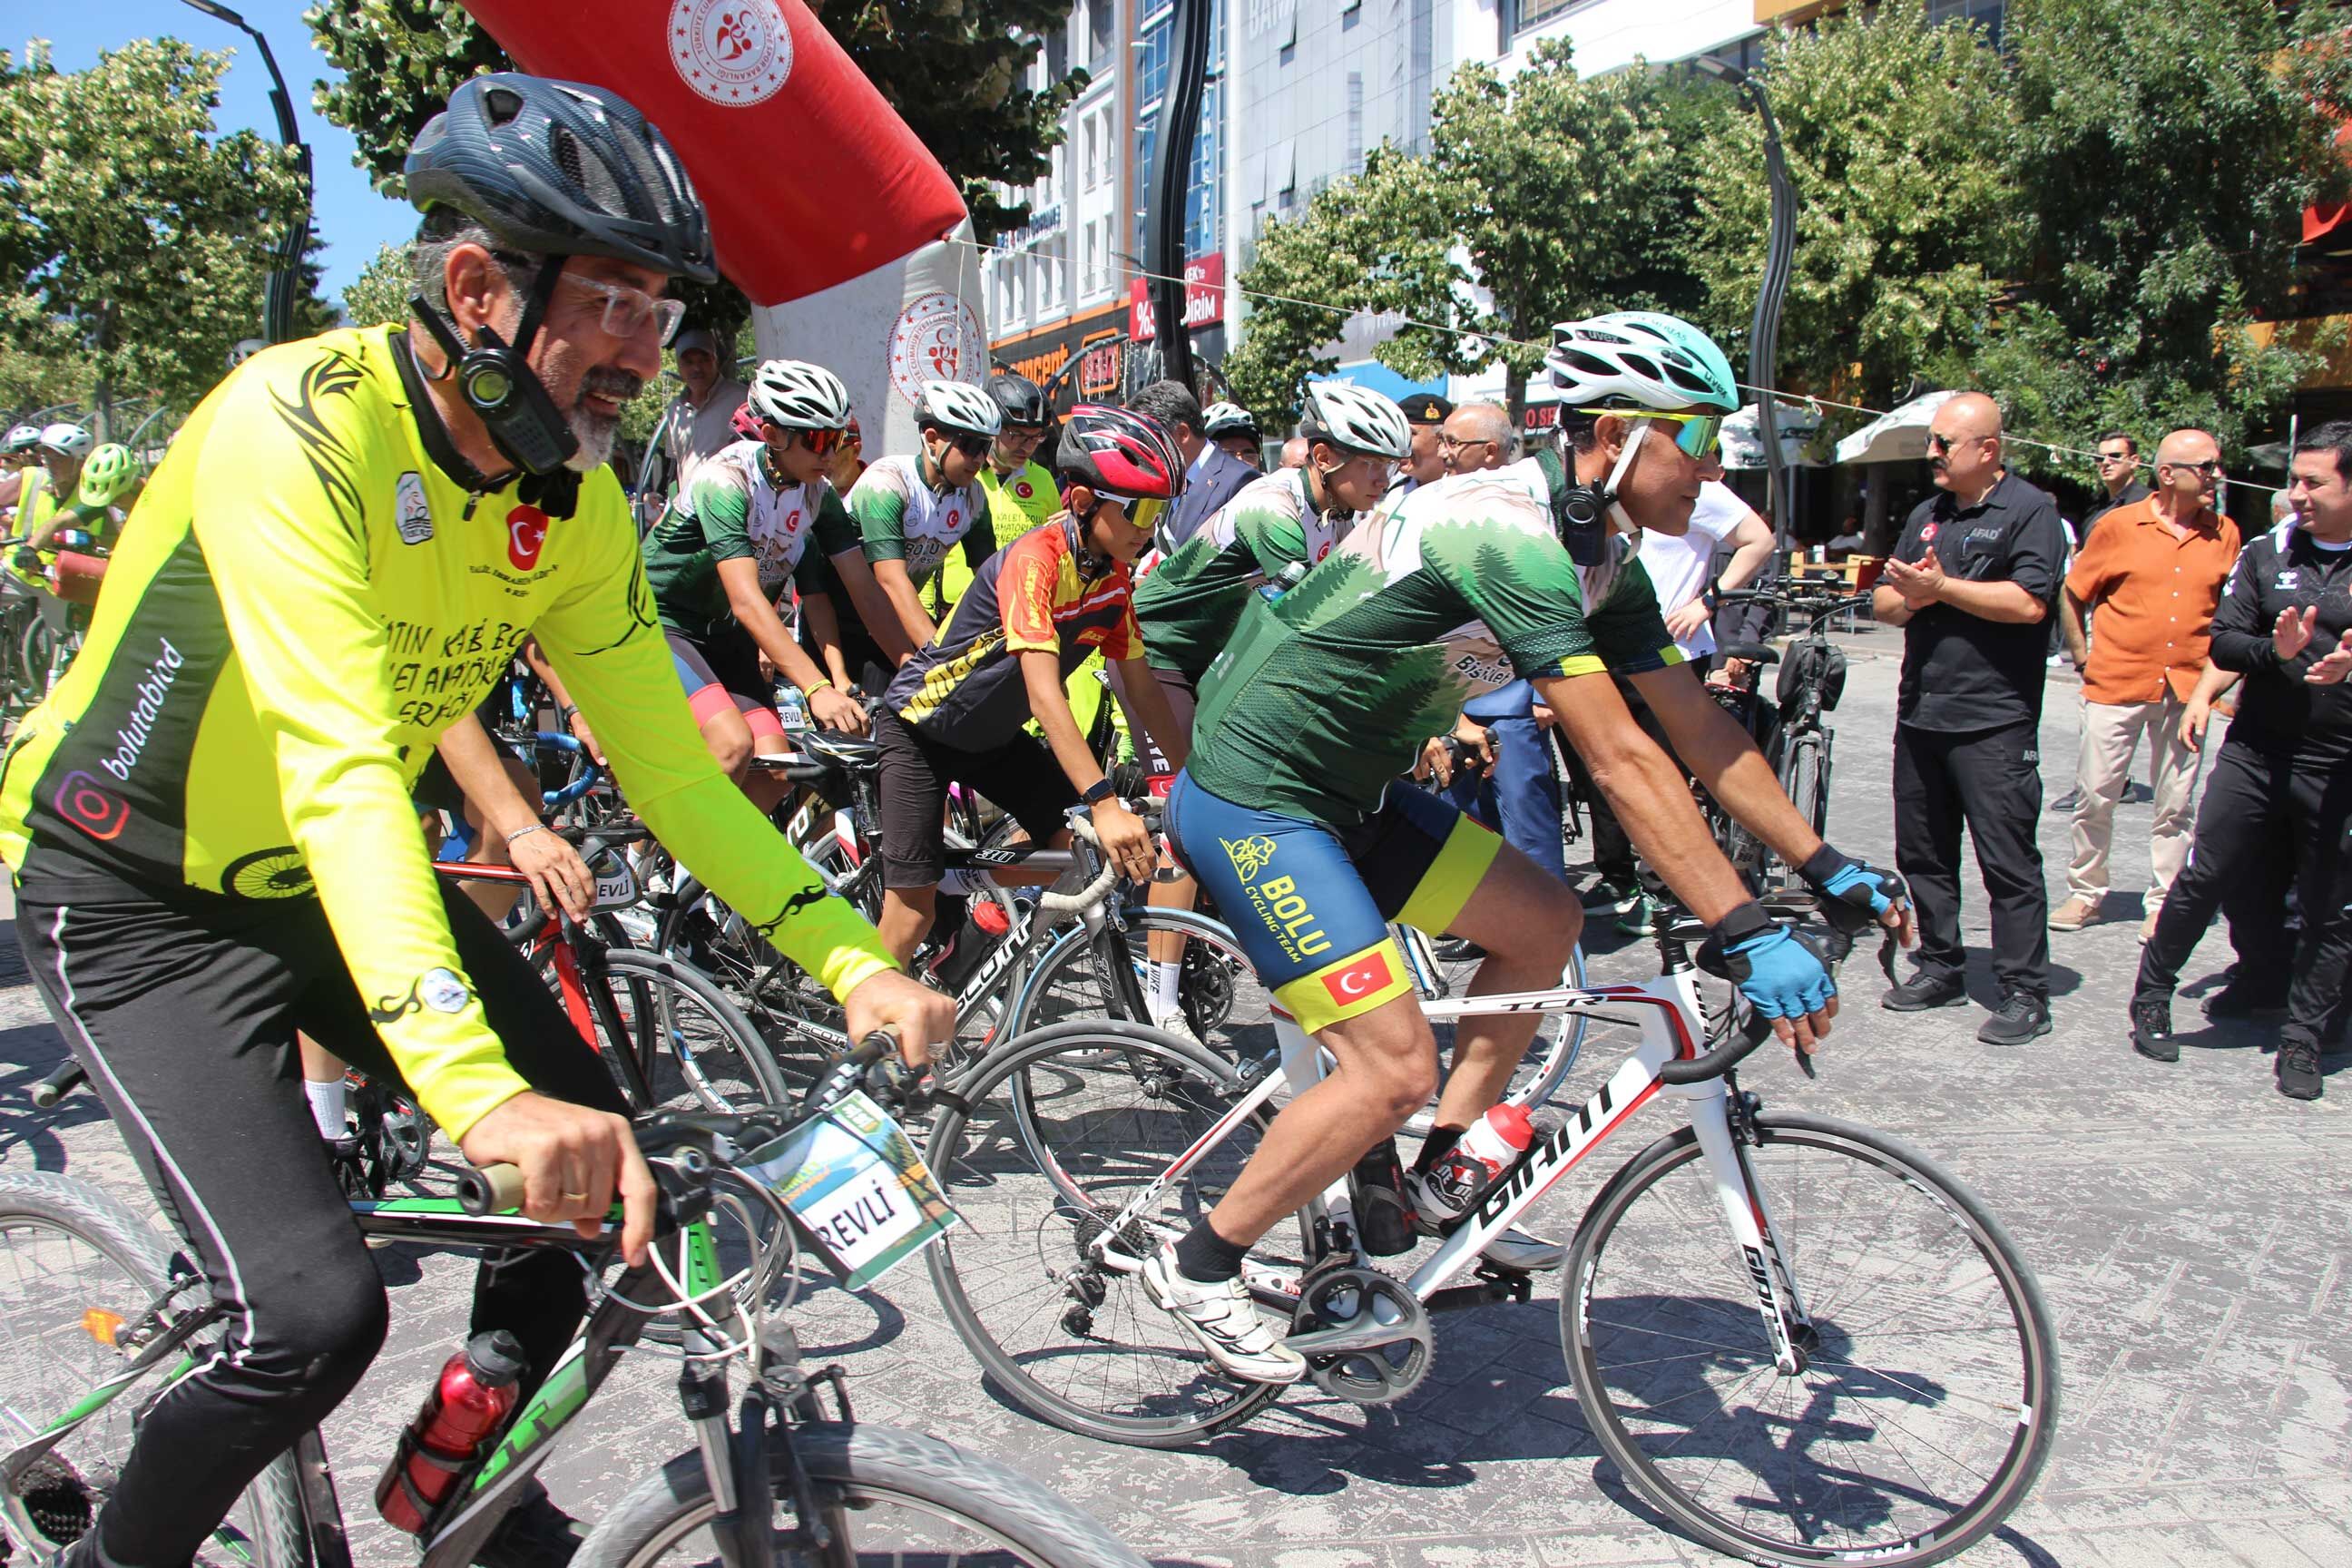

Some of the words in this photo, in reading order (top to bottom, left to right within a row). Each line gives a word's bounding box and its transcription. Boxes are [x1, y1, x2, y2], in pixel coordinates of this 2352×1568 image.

[1589, 330, 1619, 344] uvex
[1705, 371, 1728, 399] uvex
[1970, 528, 1998, 540] AFAD
[598, 875, 630, 897] EVLİ
[1244, 884, 1280, 933] CYCLING
[1275, 931, 1303, 964] TEAM
[1259, 874, 1333, 956] BOLU
[1501, 995, 1603, 1012] TCR
[1478, 1083, 1612, 1230] GIANT
